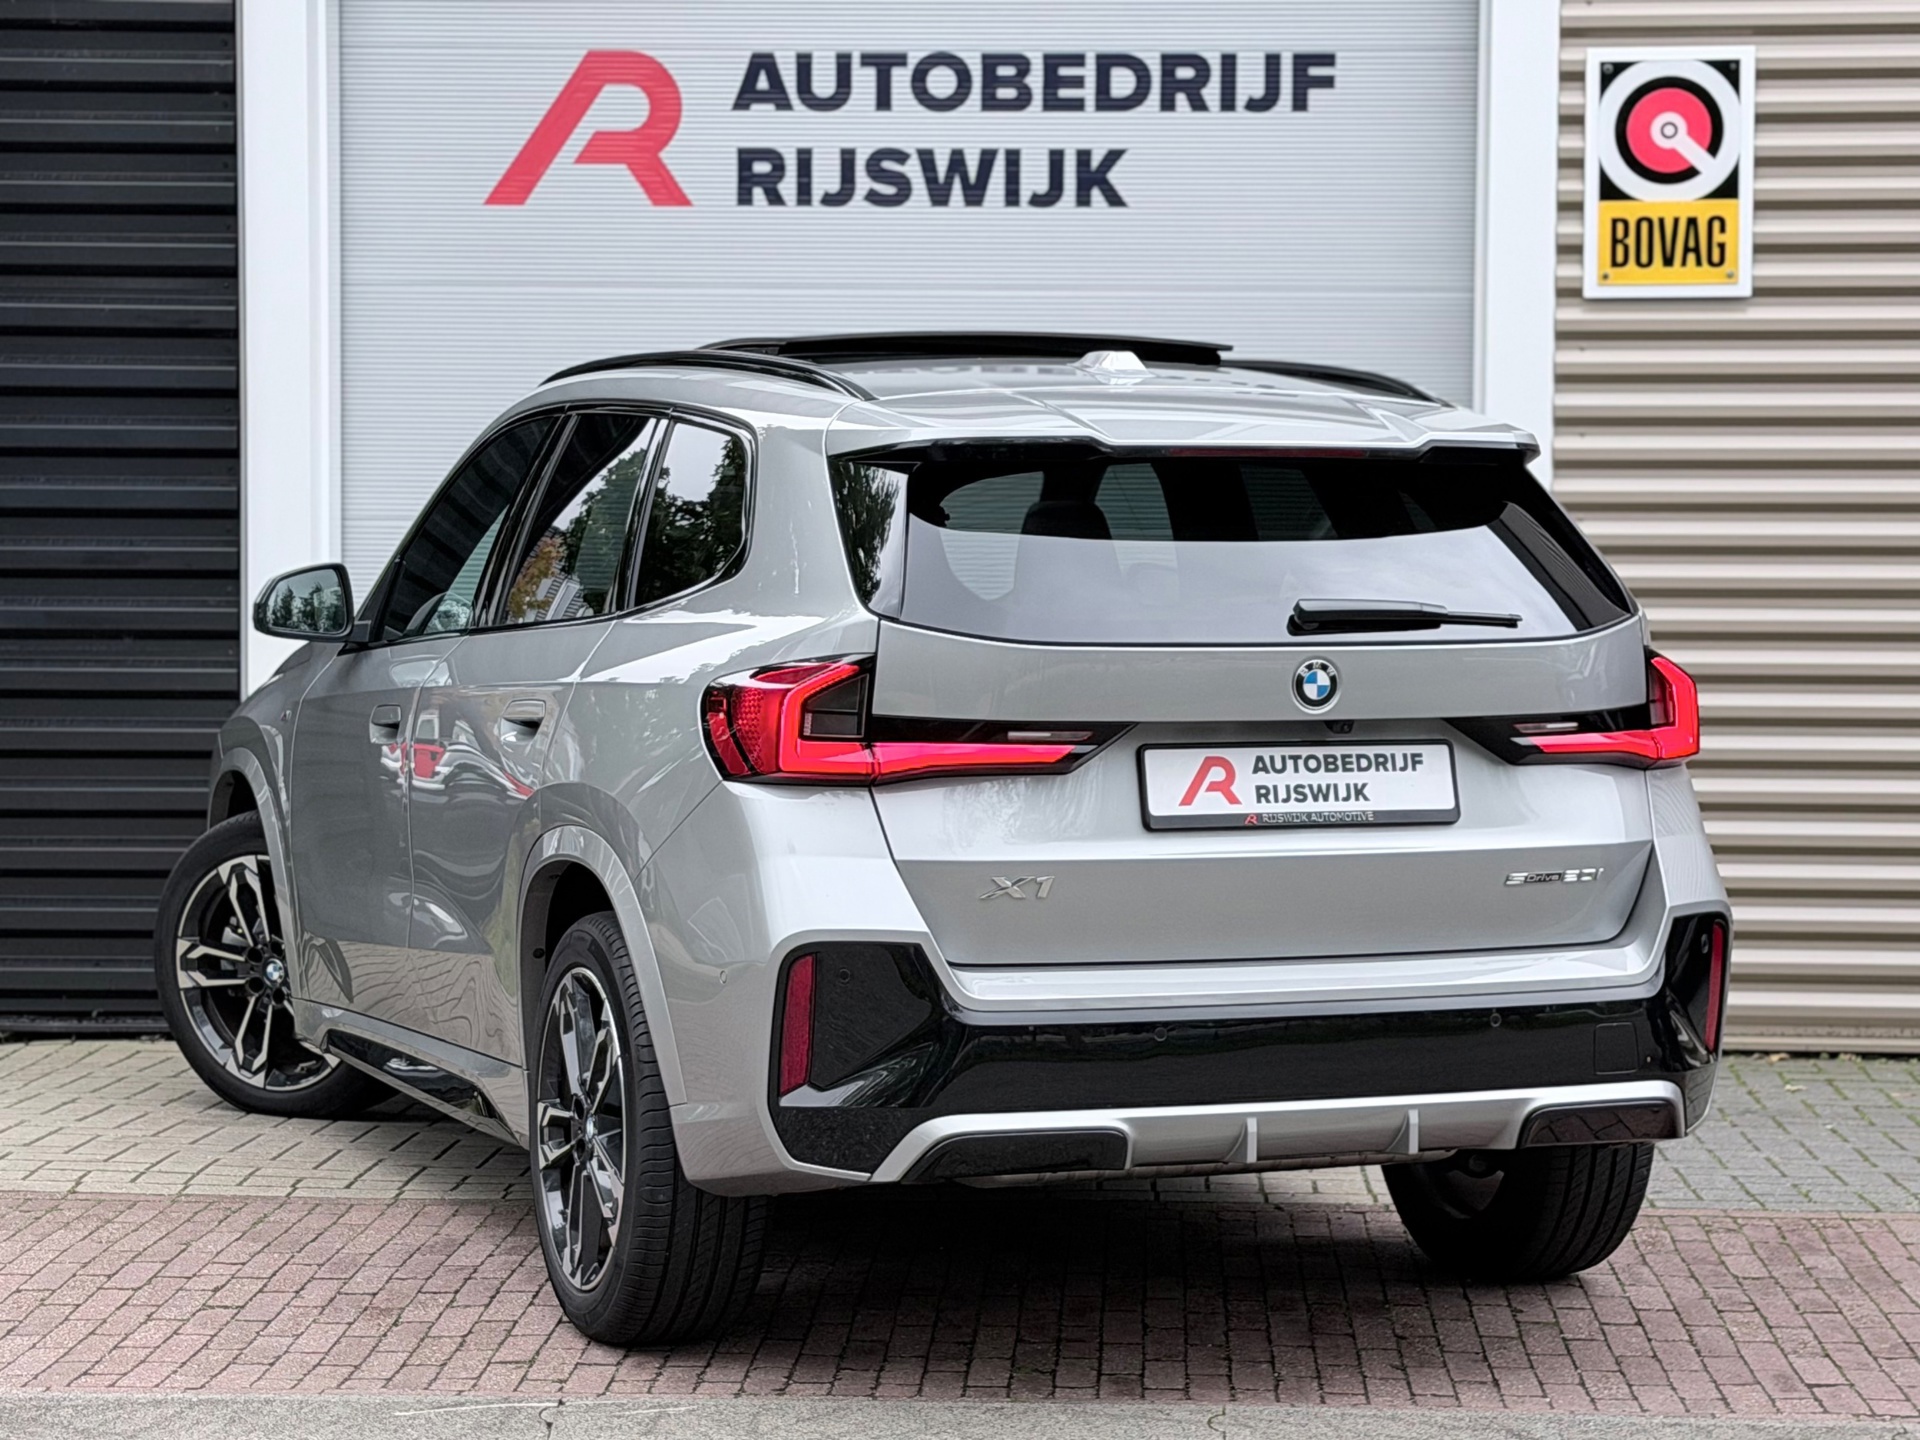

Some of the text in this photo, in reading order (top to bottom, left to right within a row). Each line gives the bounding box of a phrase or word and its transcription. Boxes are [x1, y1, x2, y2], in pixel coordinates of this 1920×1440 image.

[732, 51, 1336, 112] AUTOBEDRIJF
[736, 147, 1129, 208] RIJSWIJK
[1610, 216, 1727, 268] BOVAG
[1299, 661, 1336, 677] BMW
[1252, 752, 1423, 774] AUTOBEDRIJF
[1255, 782, 1370, 804] RIJSWIJK
[1262, 812, 1309, 823] RIJSWIJK
[1311, 811, 1374, 822] AUTOMOTIVE
[980, 875, 1055, 899] X1
